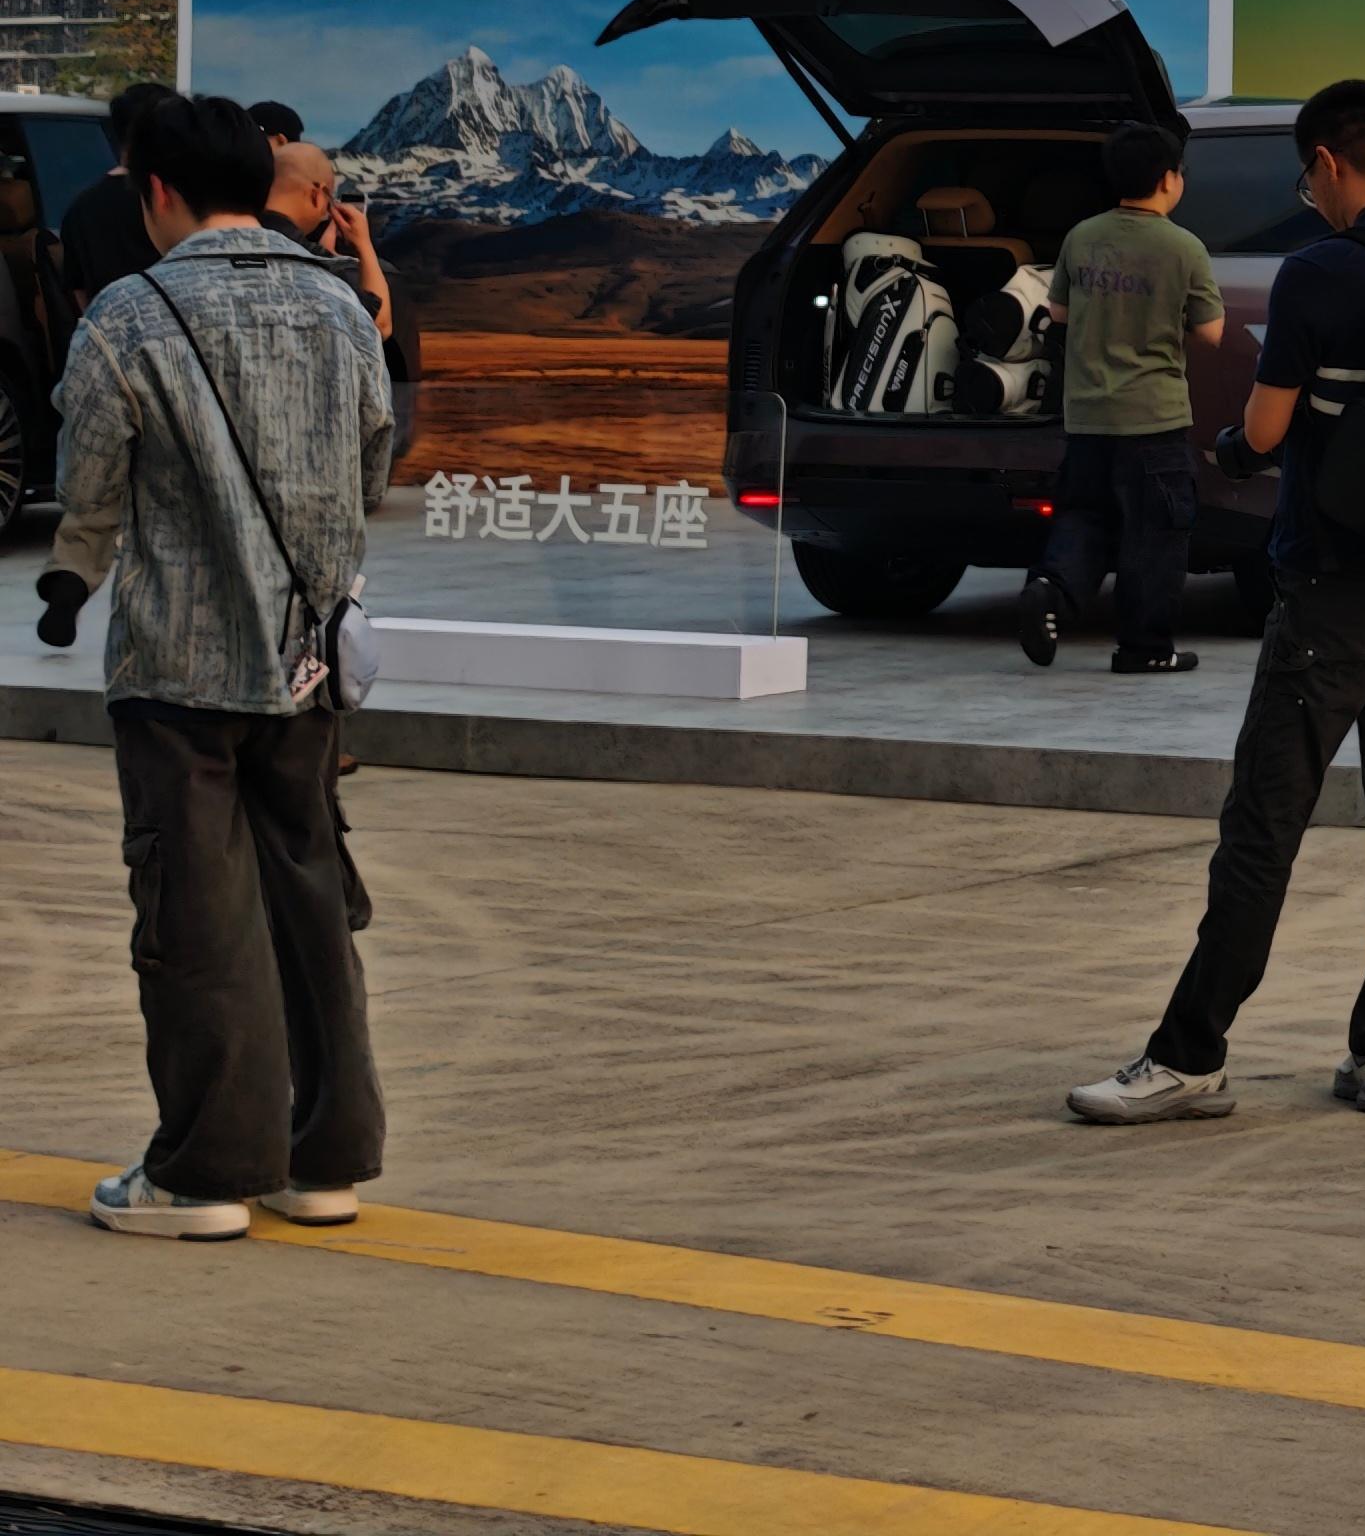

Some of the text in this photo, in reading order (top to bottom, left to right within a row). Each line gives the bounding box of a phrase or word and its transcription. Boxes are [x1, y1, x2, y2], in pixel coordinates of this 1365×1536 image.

[424, 470, 710, 549] 舒适大五座
